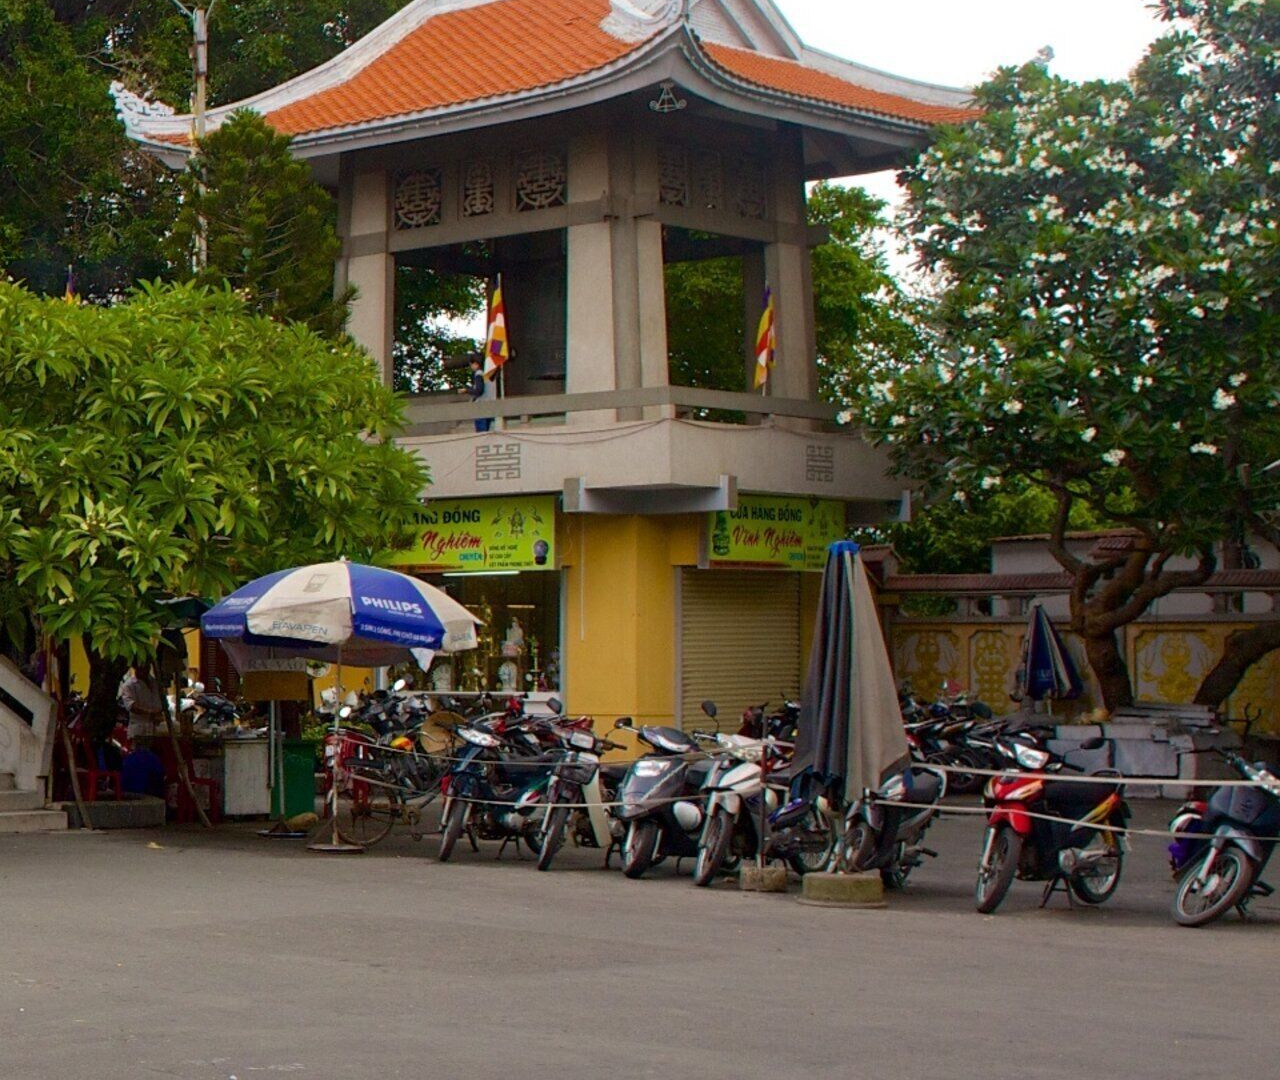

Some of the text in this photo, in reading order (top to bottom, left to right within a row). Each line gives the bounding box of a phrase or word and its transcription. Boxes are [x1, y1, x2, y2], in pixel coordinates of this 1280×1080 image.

[442, 504, 481, 524] ĐỒNG
[778, 502, 802, 522] ĐỒNG
[421, 530, 482, 561] Nghiêm
[360, 596, 423, 614] PHILIPS
